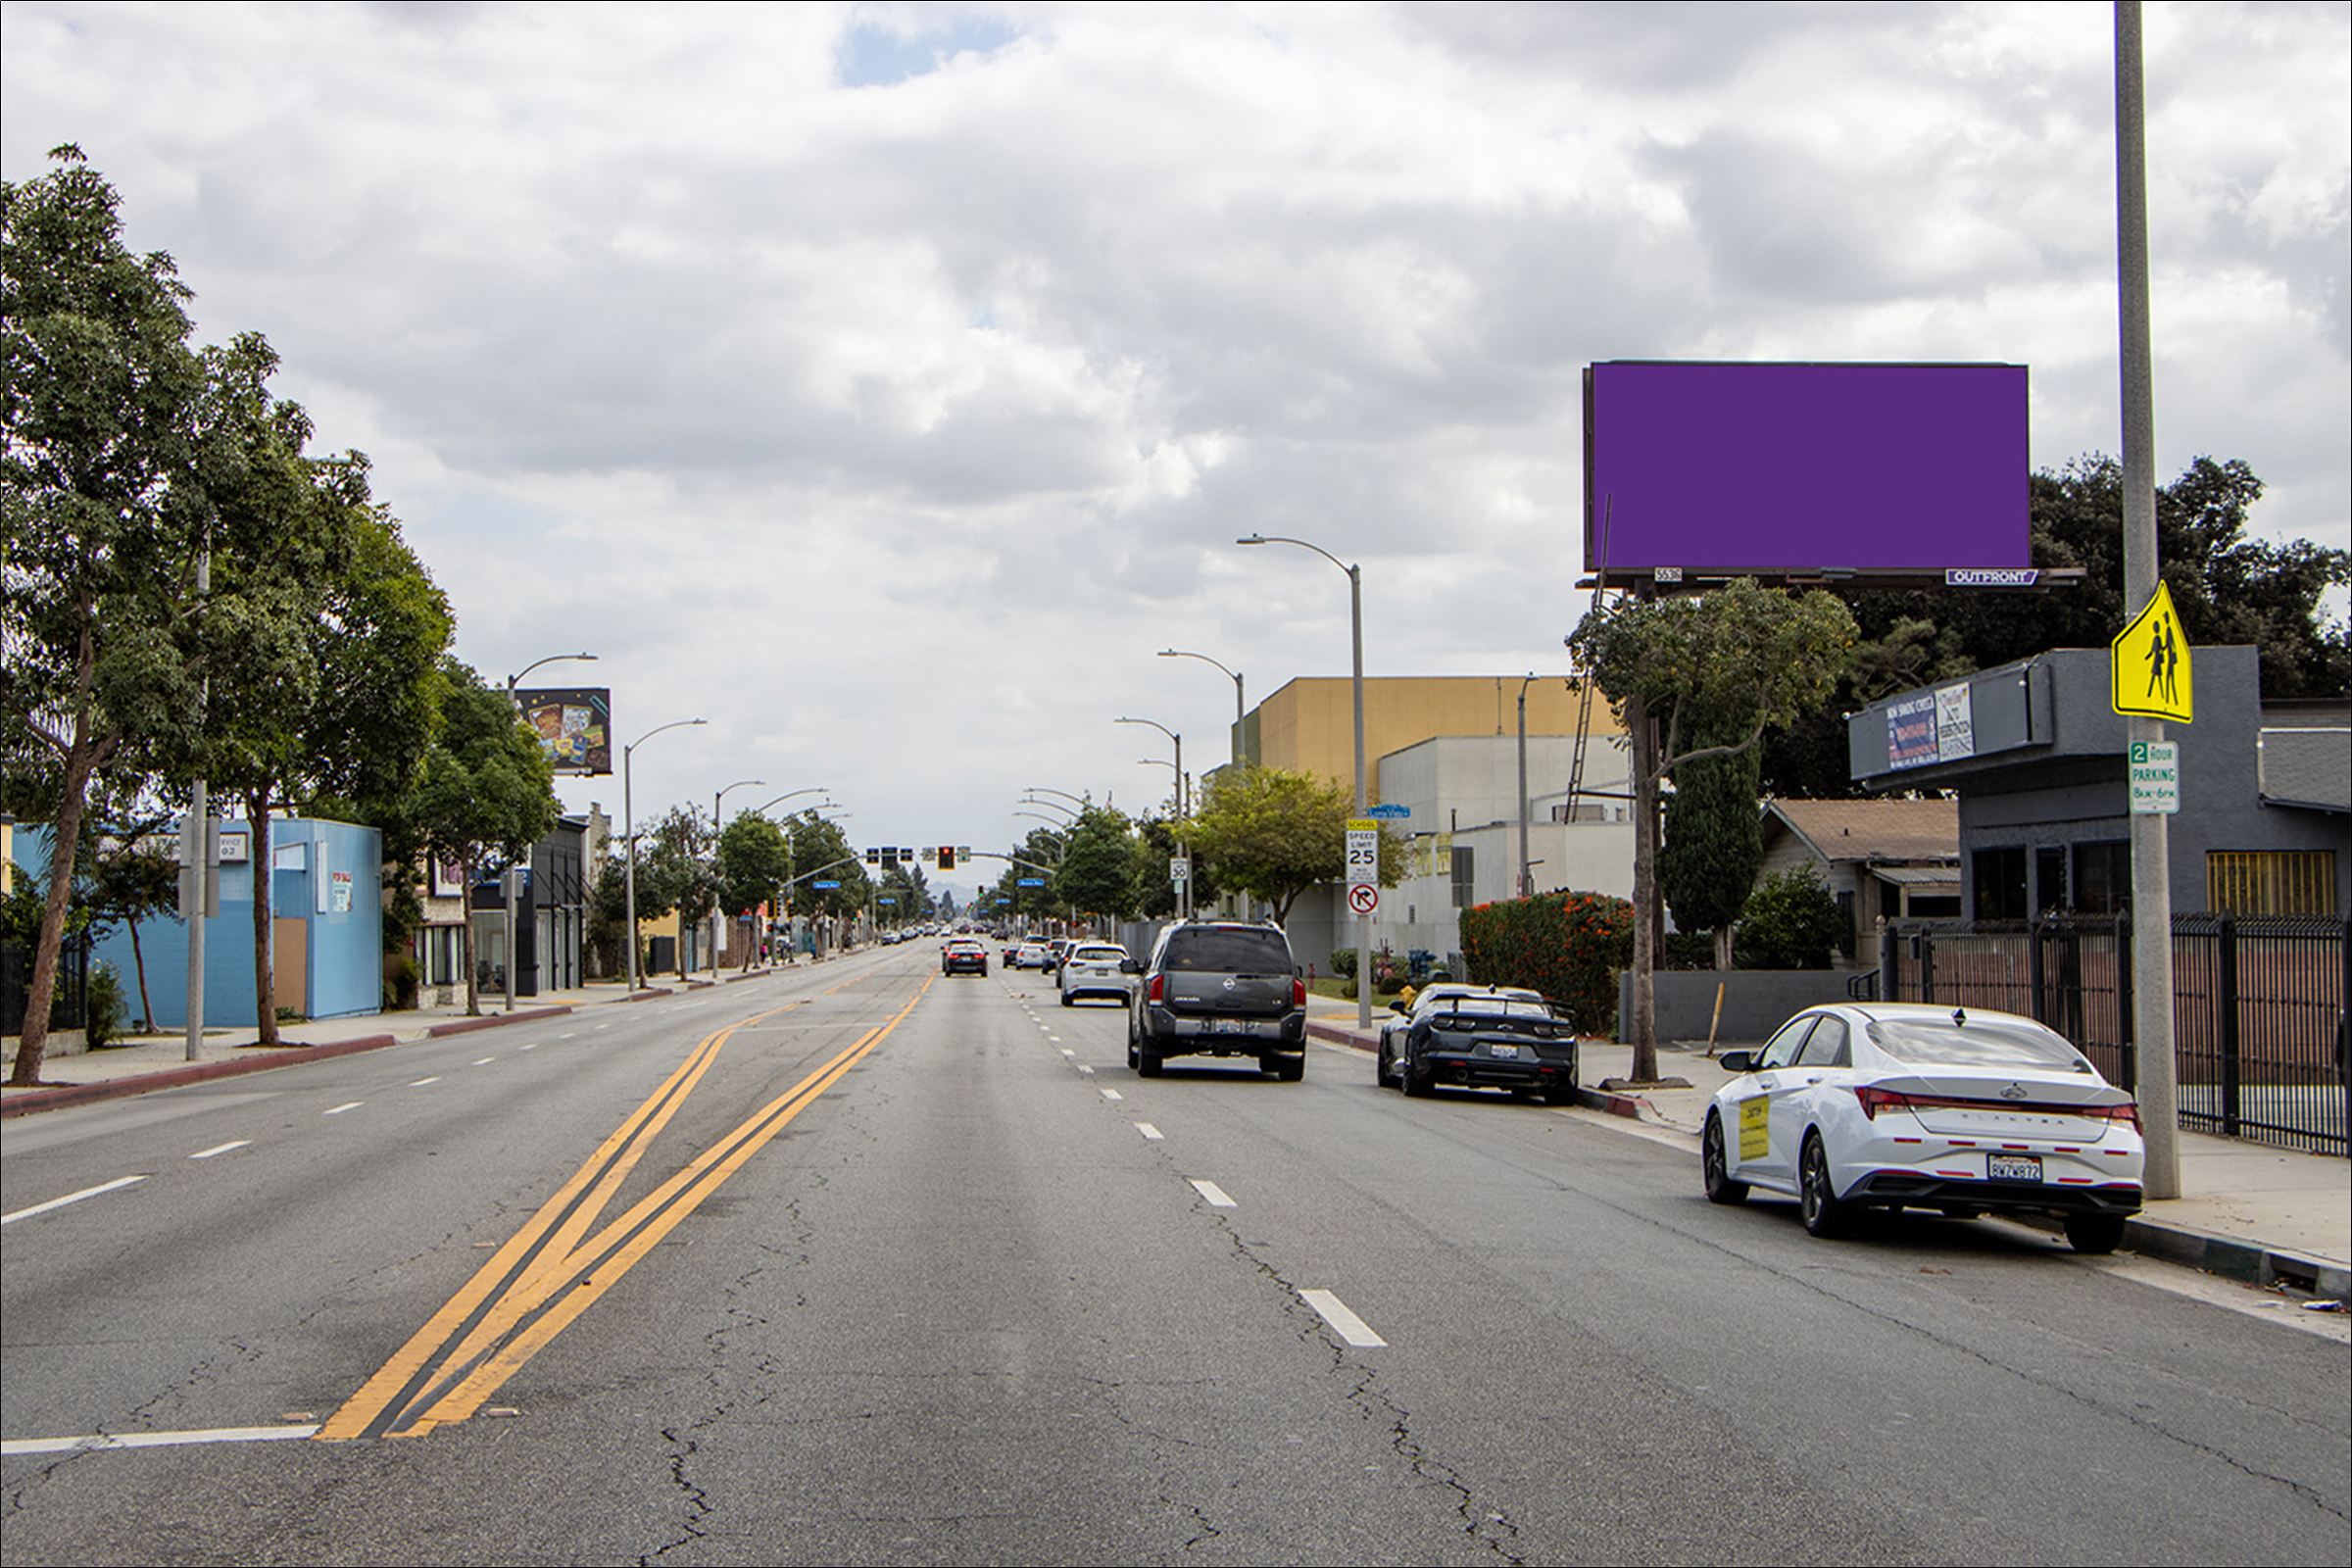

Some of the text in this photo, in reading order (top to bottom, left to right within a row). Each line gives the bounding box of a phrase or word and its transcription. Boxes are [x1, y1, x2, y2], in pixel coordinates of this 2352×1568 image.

[1954, 571, 2028, 583] OUTFRONT
[2134, 745, 2145, 760] 2
[2150, 748, 2173, 760] HOUR
[2132, 768, 2176, 782] PARKING
[1349, 850, 1375, 865] 25
